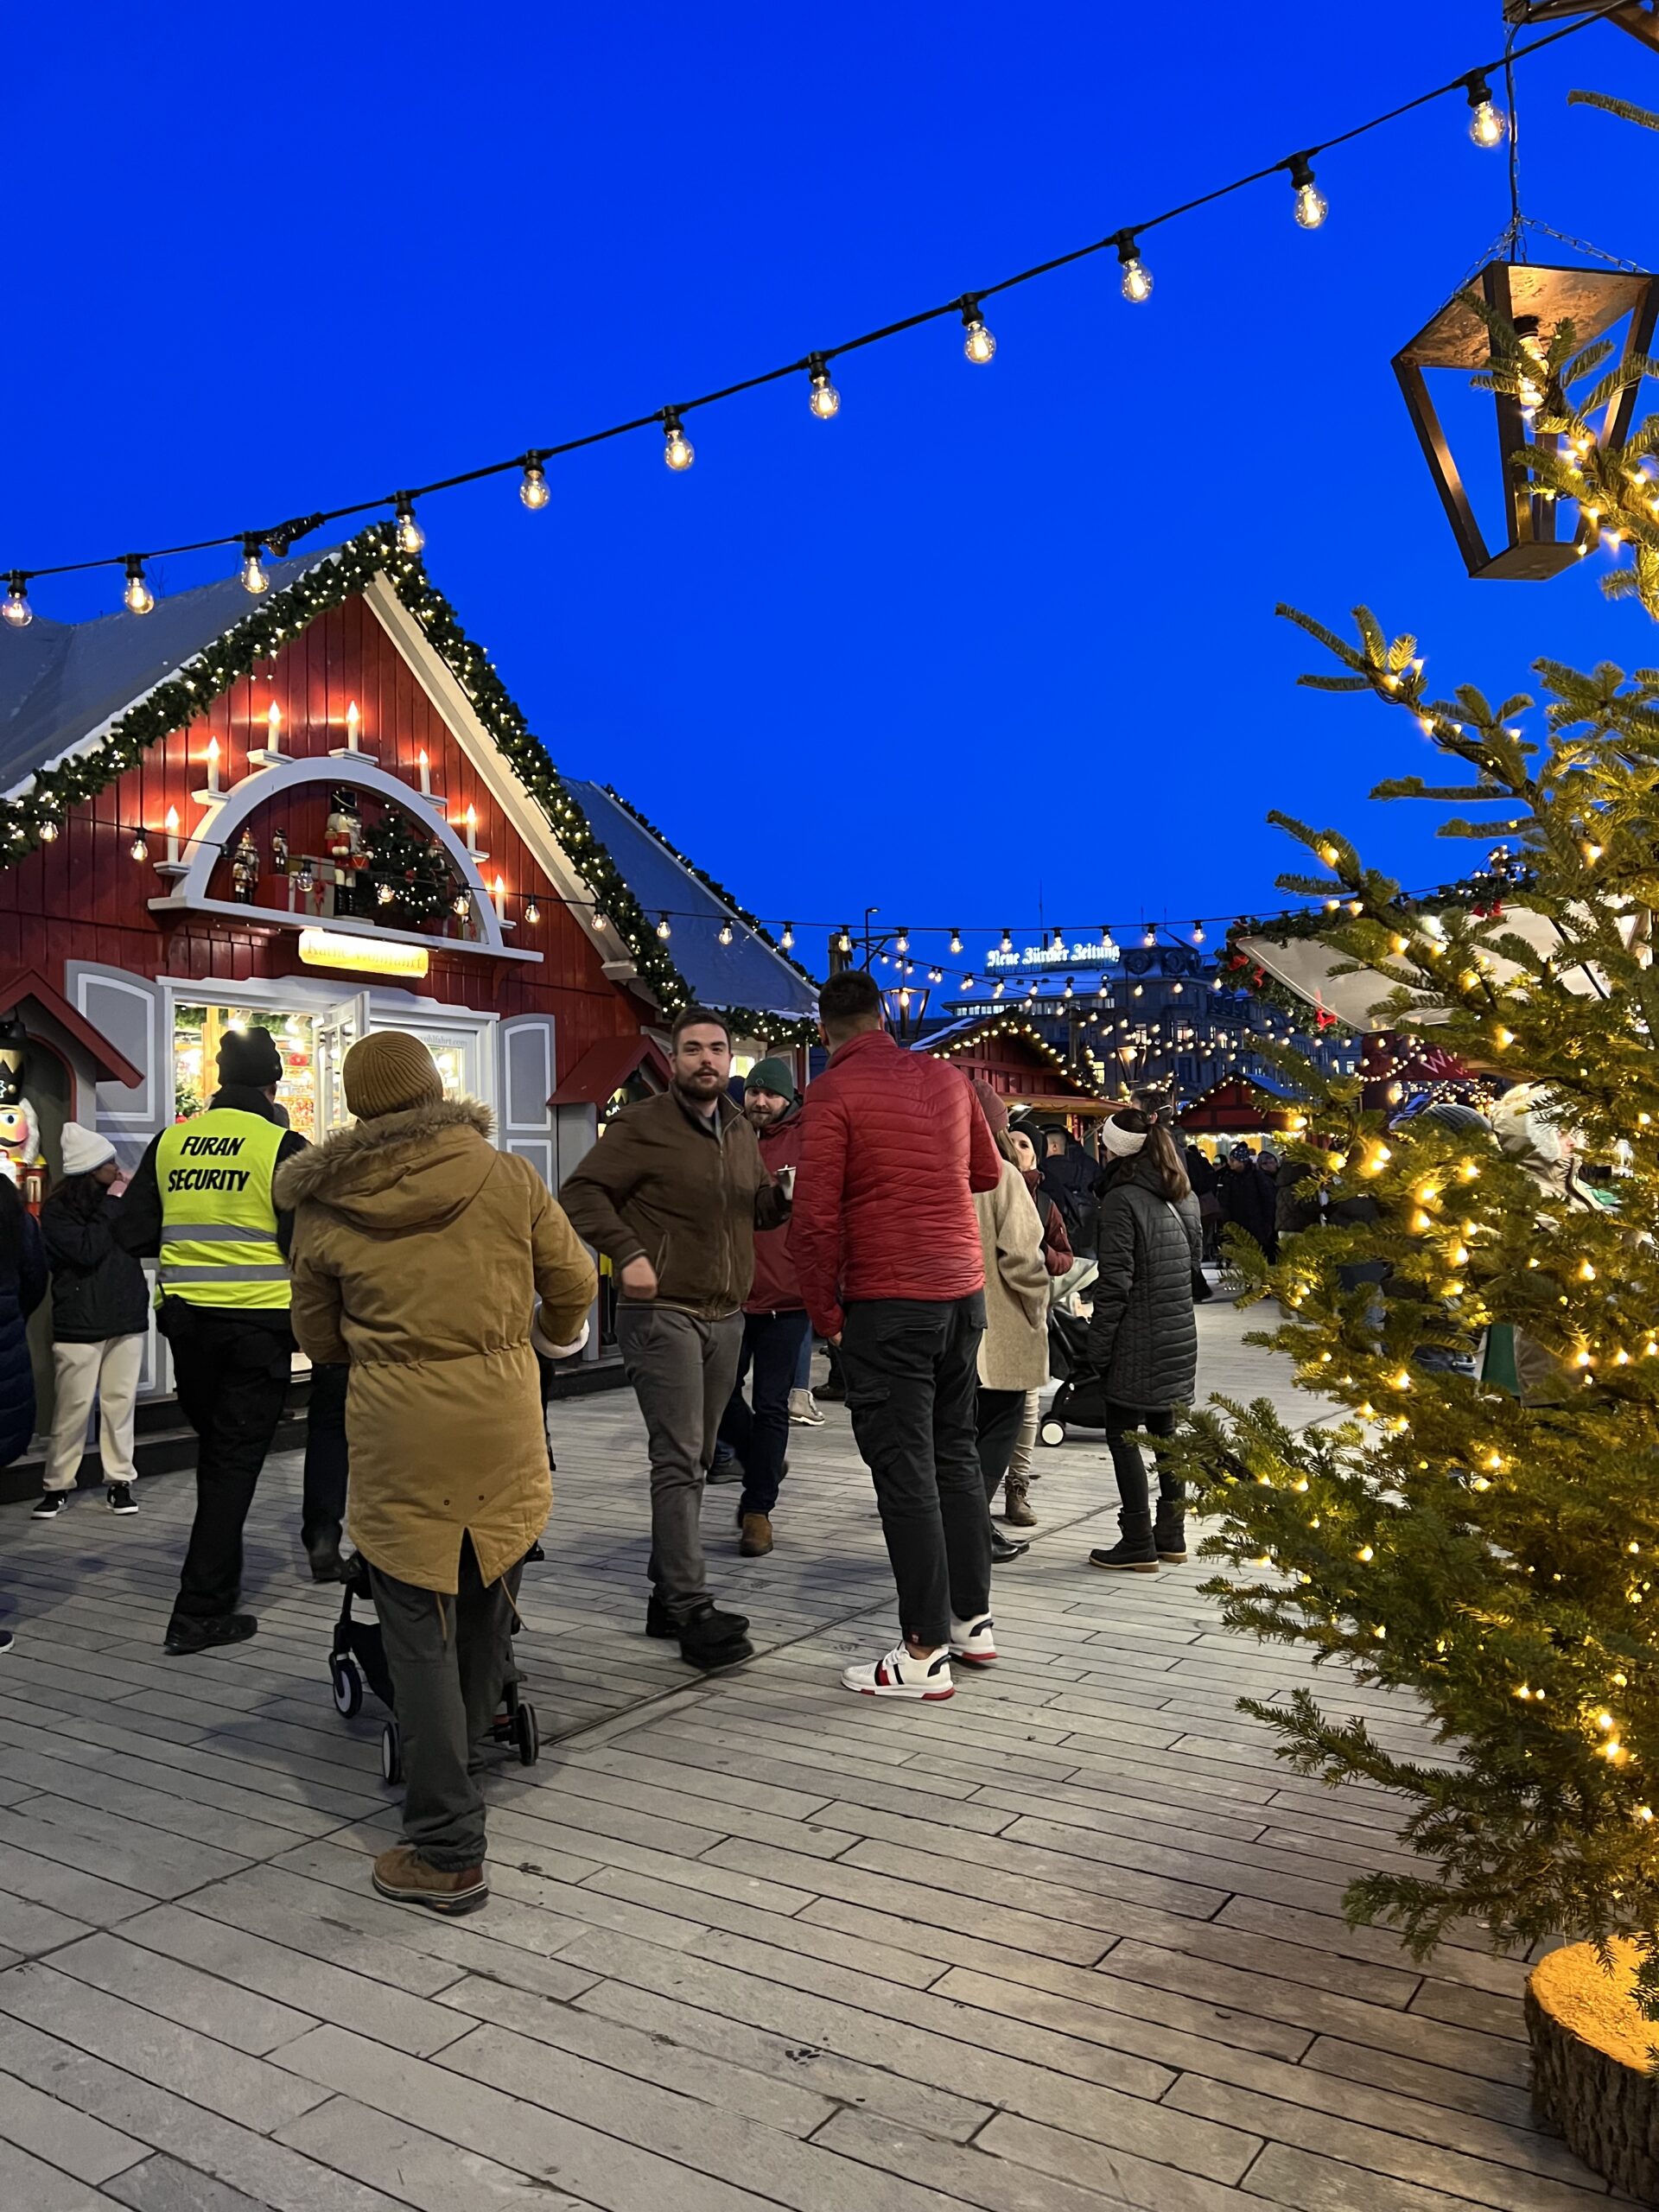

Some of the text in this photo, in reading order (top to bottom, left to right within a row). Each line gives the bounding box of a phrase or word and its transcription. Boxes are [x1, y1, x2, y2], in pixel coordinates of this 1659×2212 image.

[987, 943, 1121, 967] Neue Zürcher Zeitung
[180, 1136, 245, 1156] FURAN
[168, 1169, 251, 1192] SECURITY
